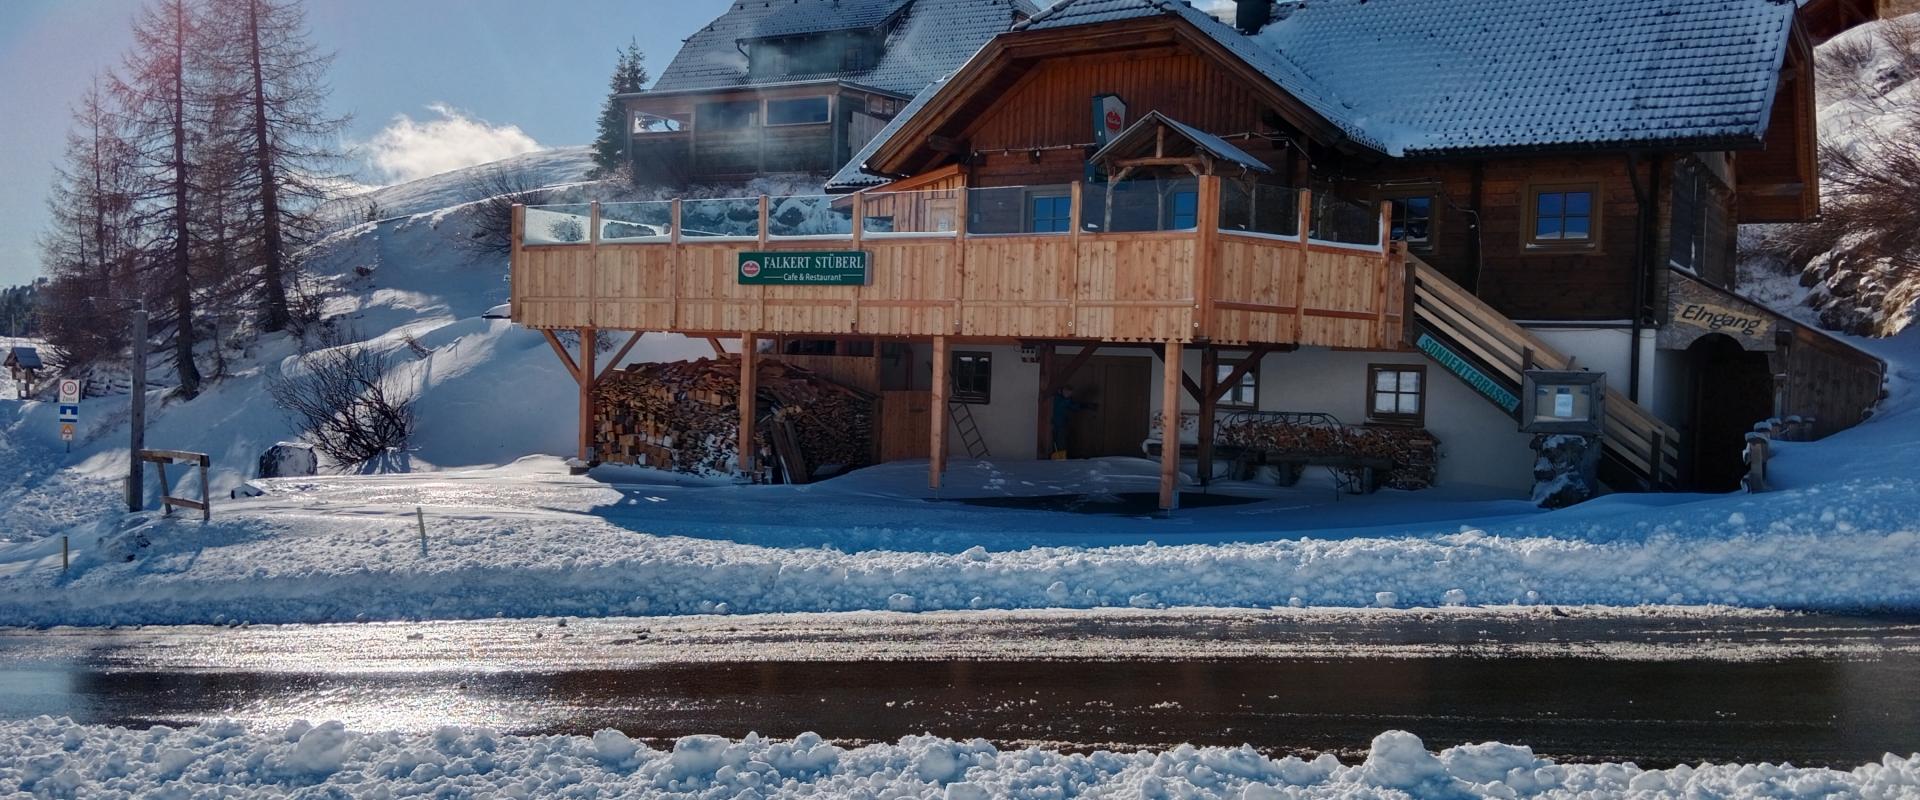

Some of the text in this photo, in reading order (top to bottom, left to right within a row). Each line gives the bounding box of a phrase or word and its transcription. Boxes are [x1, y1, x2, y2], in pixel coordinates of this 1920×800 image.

[764, 253, 864, 269] FALKERT STÜBERL
[783, 273, 798, 281] Cafe
[805, 273, 842, 281] Restaurant
[1422, 338, 1517, 409] SONNENTERRASSE
